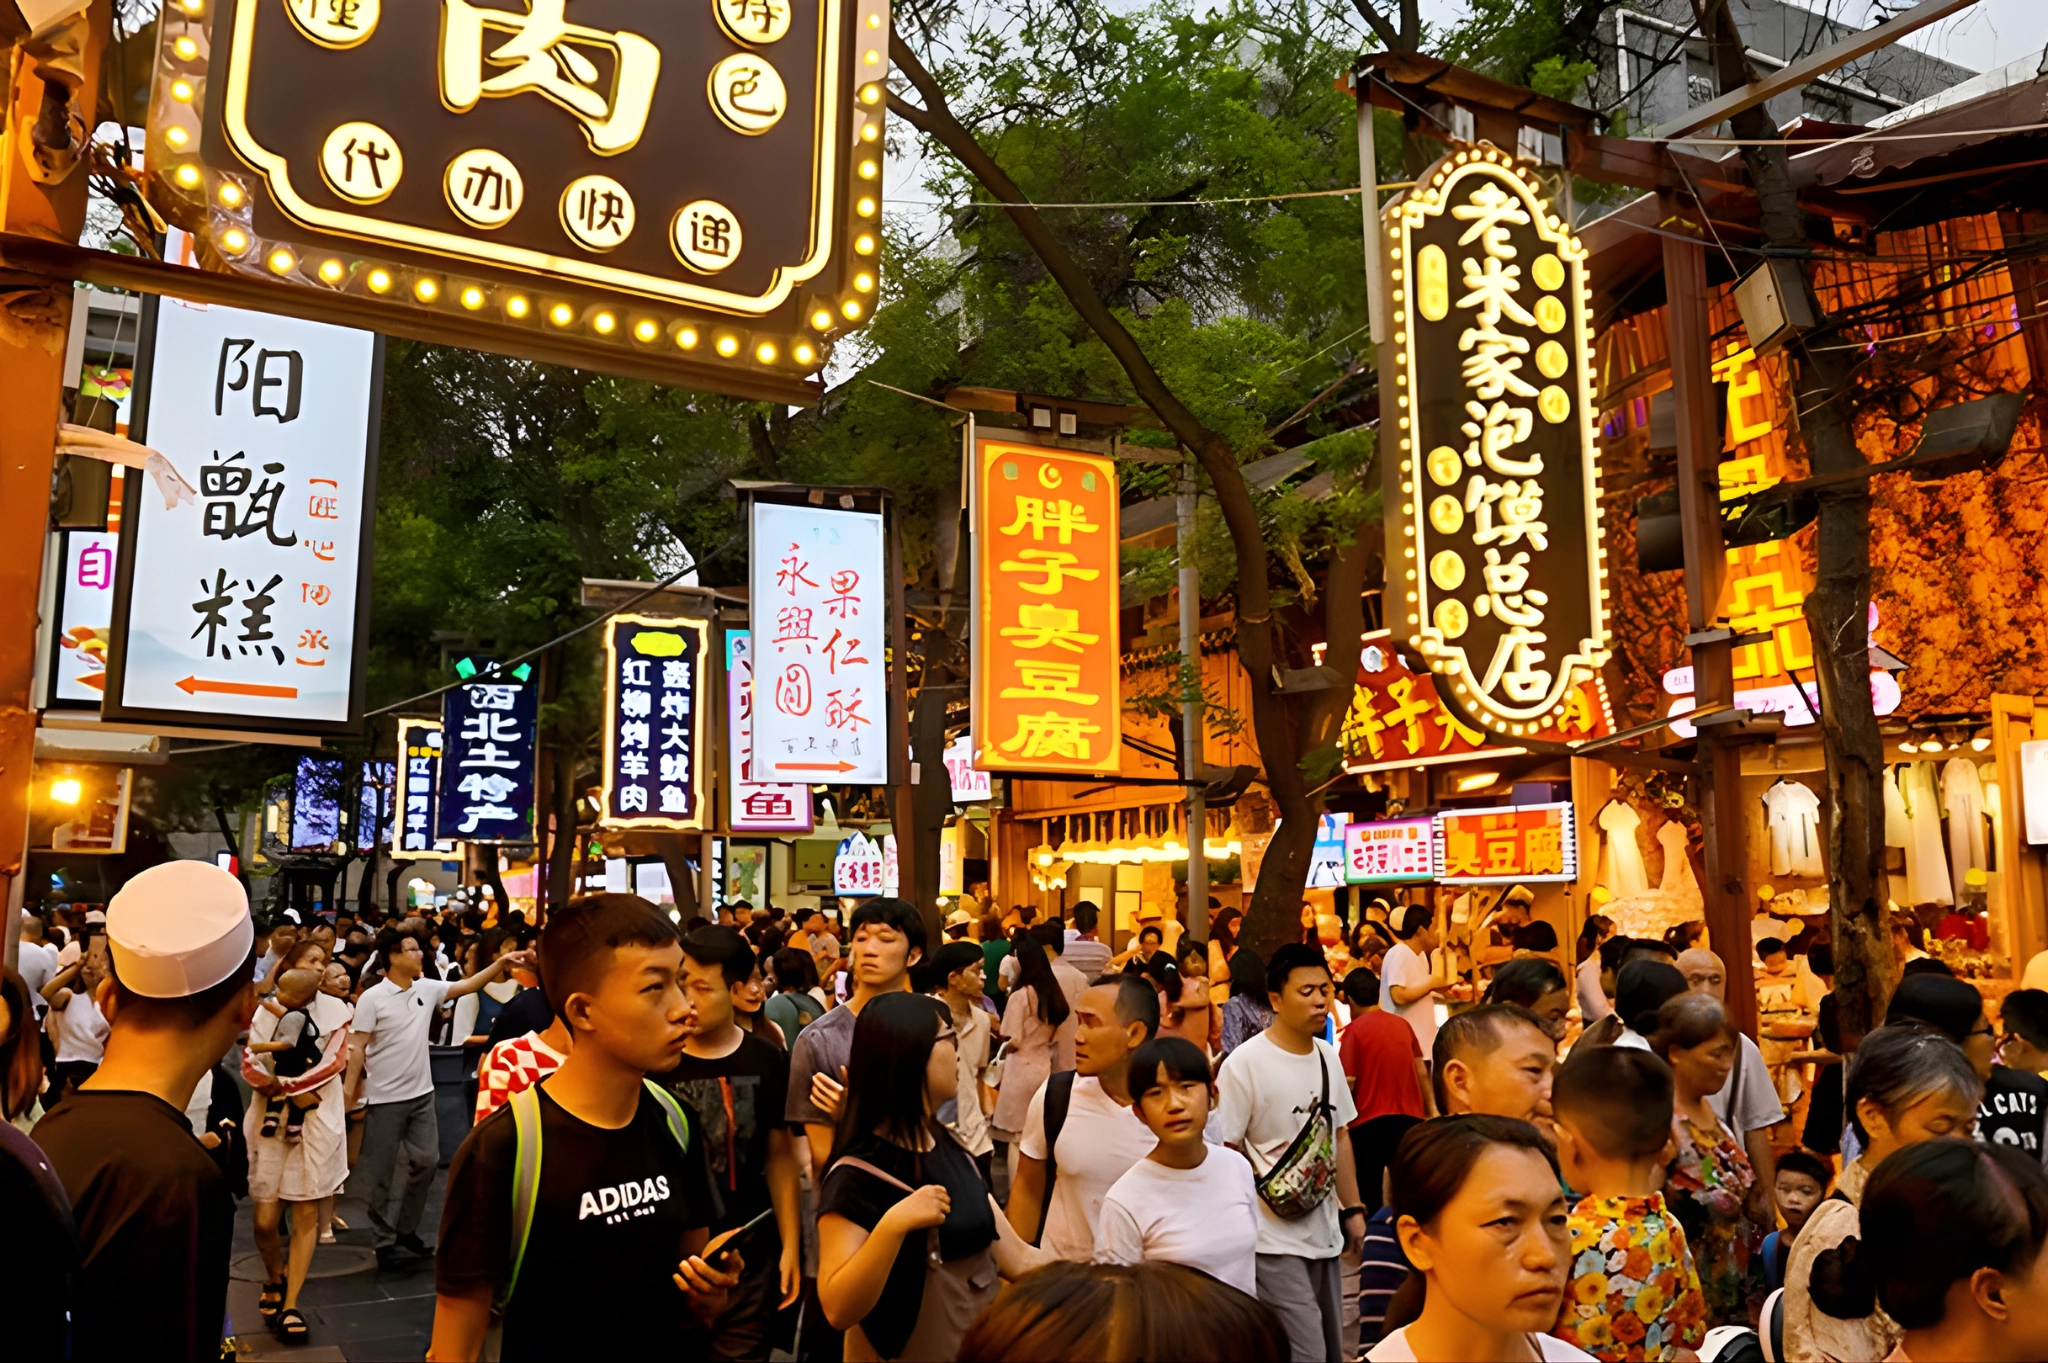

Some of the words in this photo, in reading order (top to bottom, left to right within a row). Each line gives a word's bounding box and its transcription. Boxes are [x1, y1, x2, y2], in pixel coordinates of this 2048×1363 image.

[342, 137, 731, 258] 代办快递
[1451, 182, 1552, 702] 老米家泡馍总店
[1000, 495, 1101, 760] 胖子臭豆腐
[1445, 826, 1563, 876] 臭豆腐
[578, 1175, 671, 1221] ADIDAS
